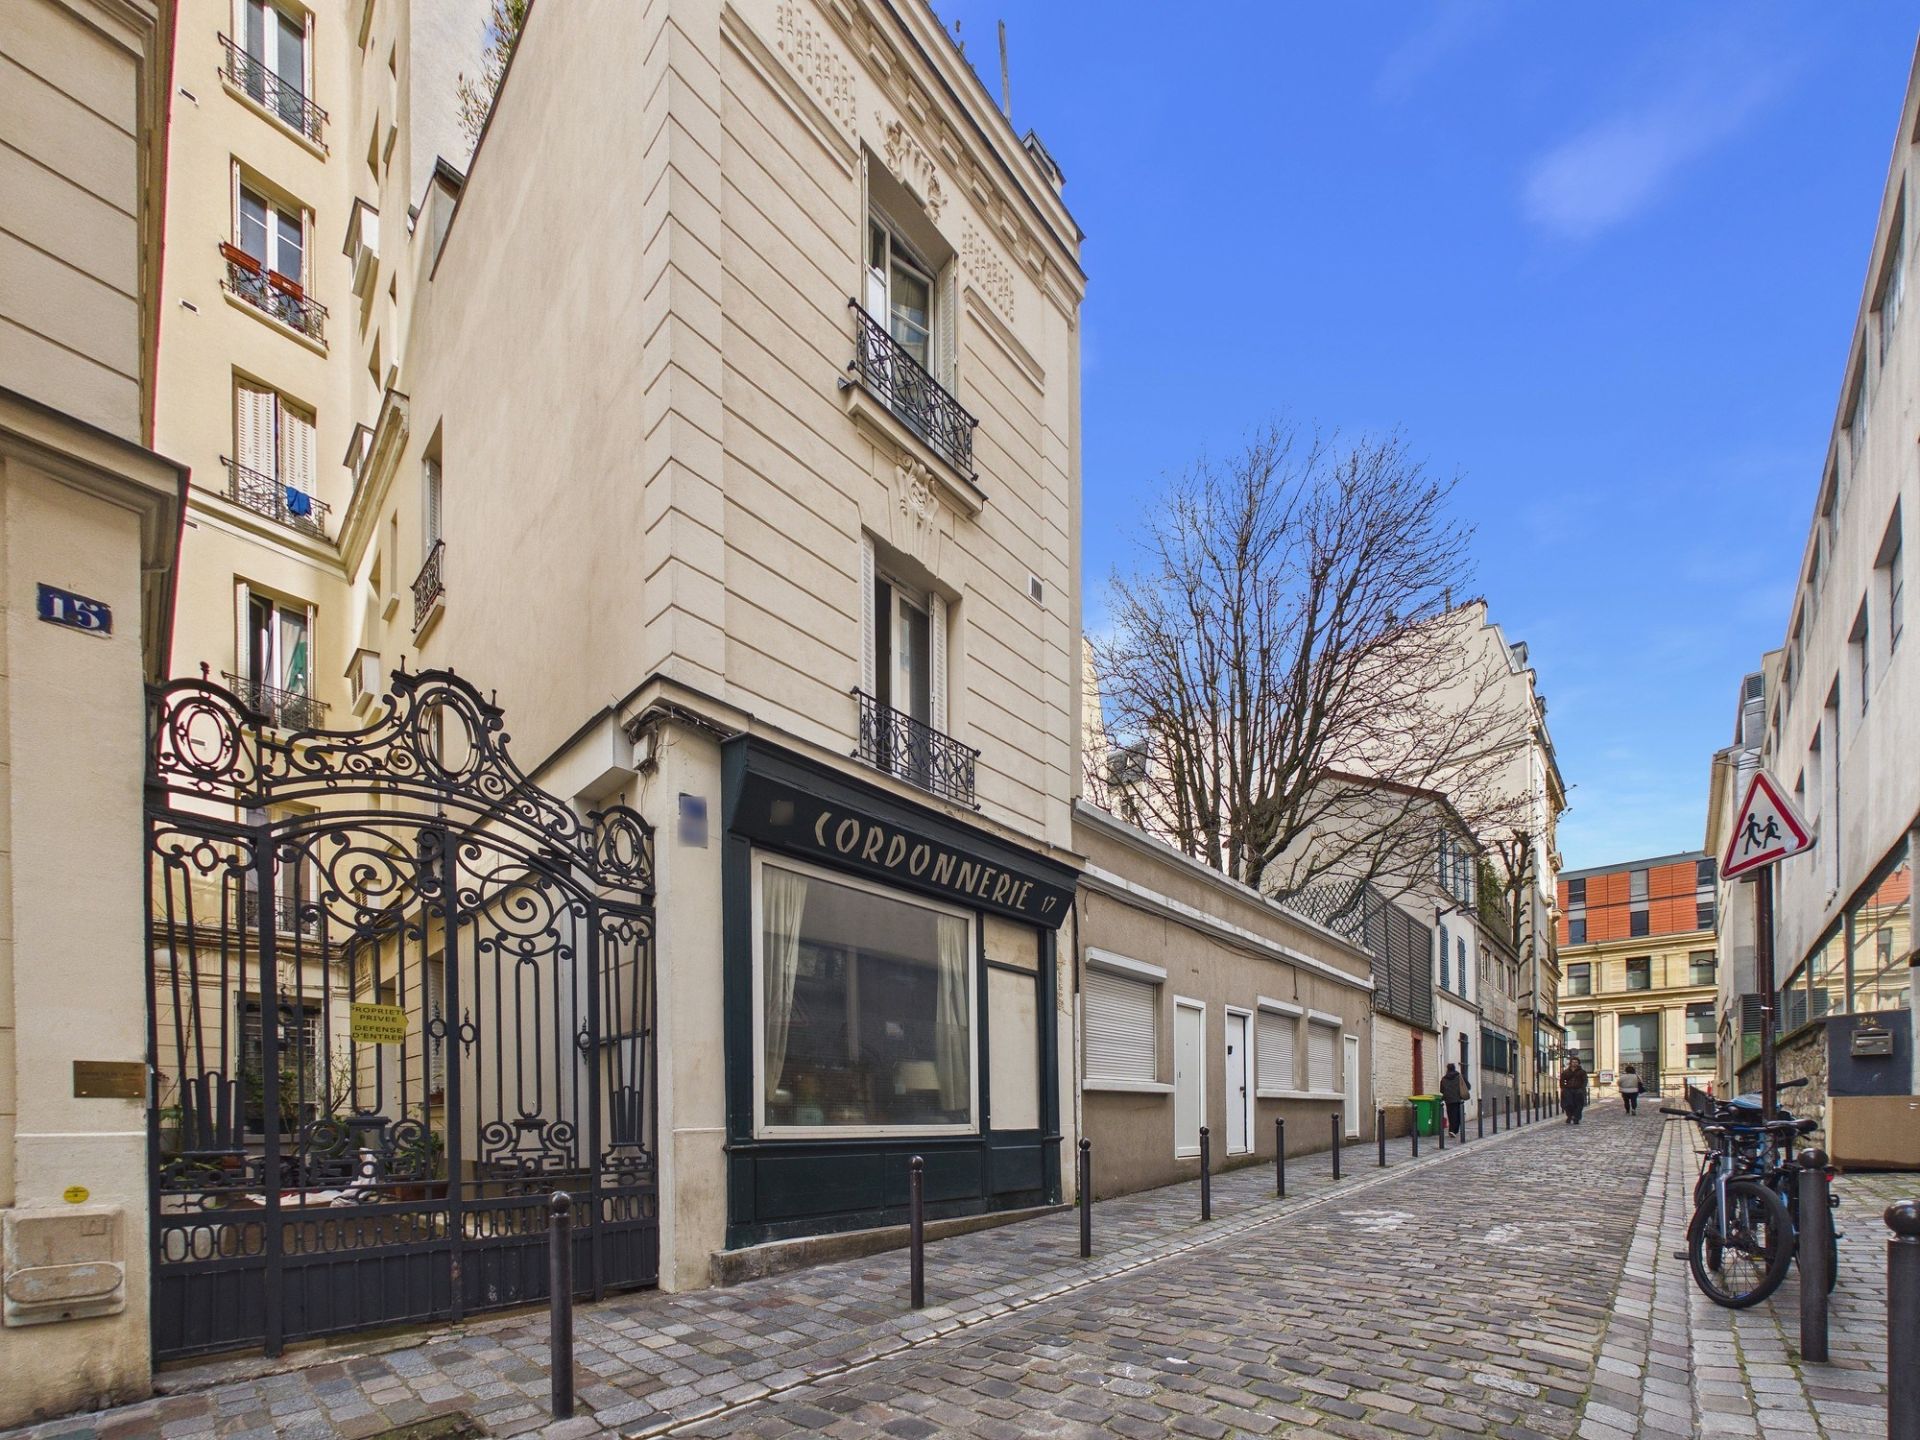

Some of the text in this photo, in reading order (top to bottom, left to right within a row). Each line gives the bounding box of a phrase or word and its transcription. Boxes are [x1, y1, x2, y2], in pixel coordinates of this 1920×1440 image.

[49, 594, 100, 629] 15
[814, 811, 1057, 913] CORDONNERIE 17
[354, 1025, 404, 1034] DEFENSE
